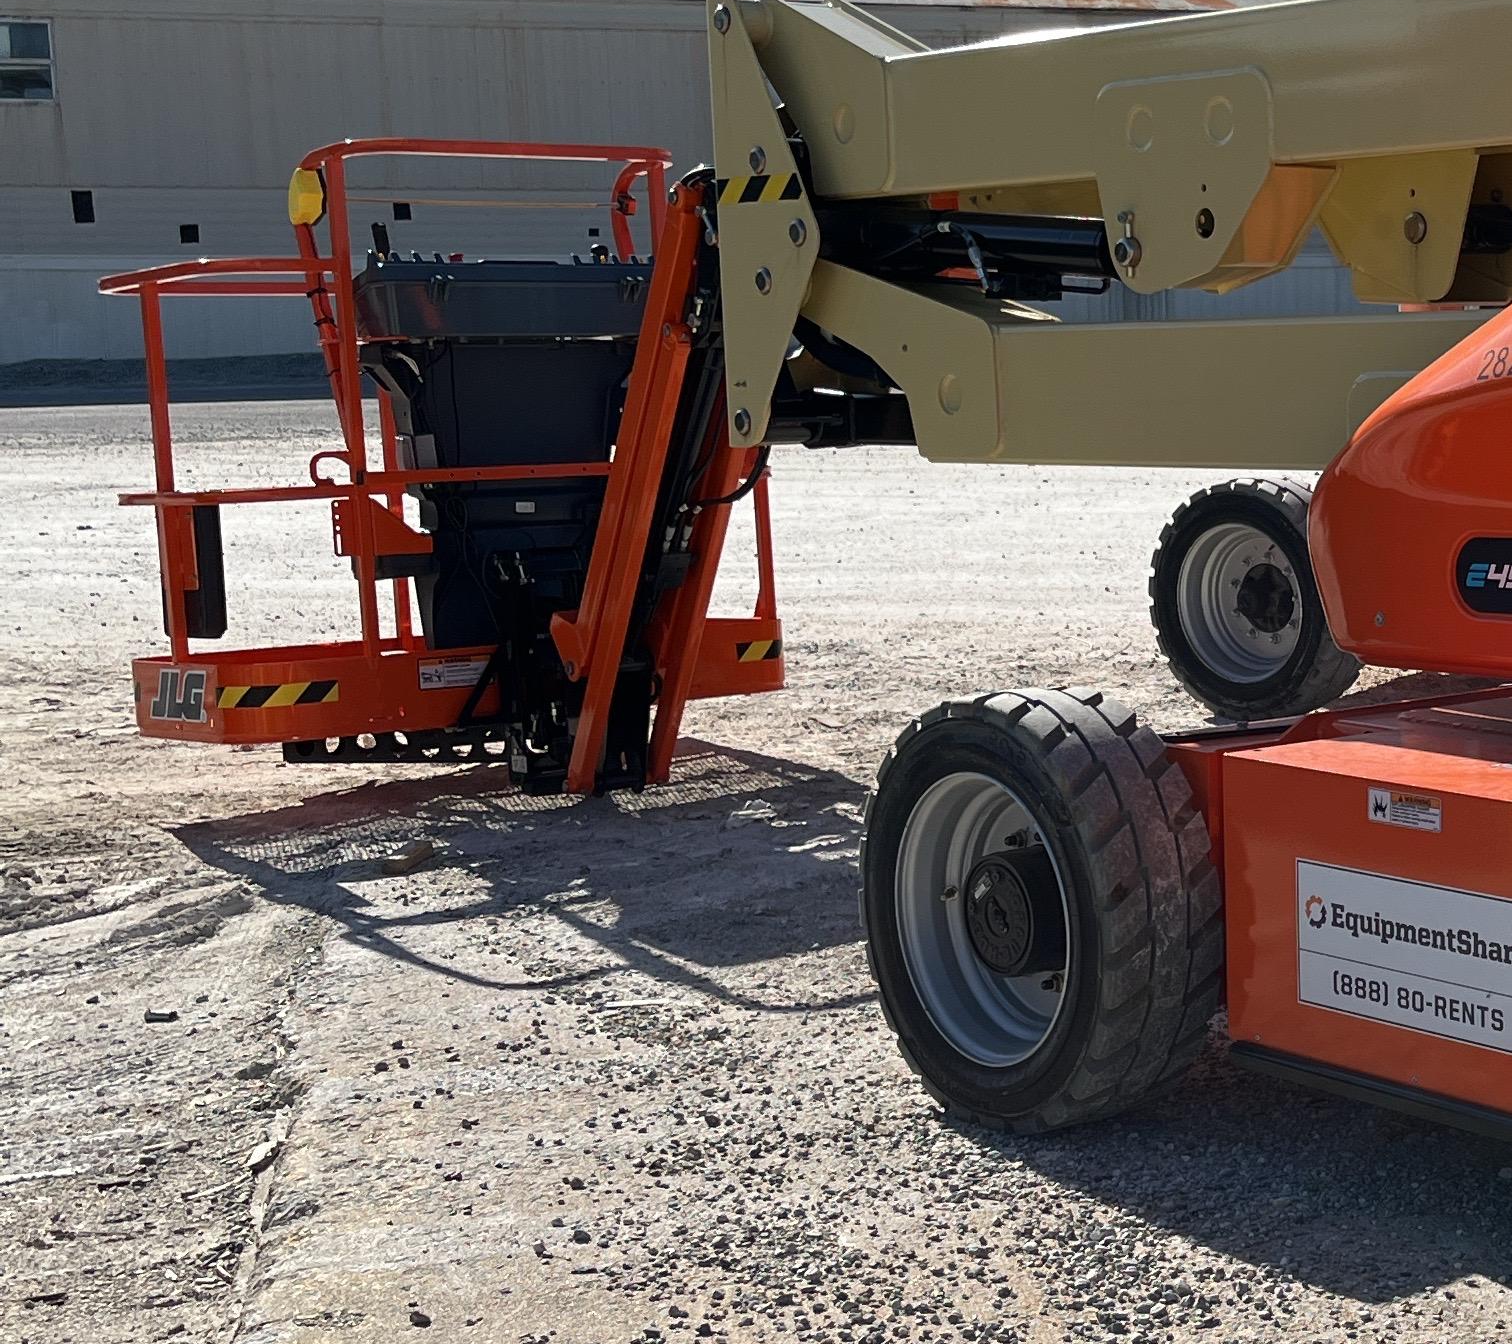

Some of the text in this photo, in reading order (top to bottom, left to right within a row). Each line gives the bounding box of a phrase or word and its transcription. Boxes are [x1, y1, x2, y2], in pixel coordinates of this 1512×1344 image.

[150, 668, 207, 723] JLG
[1333, 969, 1505, 1032] (888) 80-RENTS
